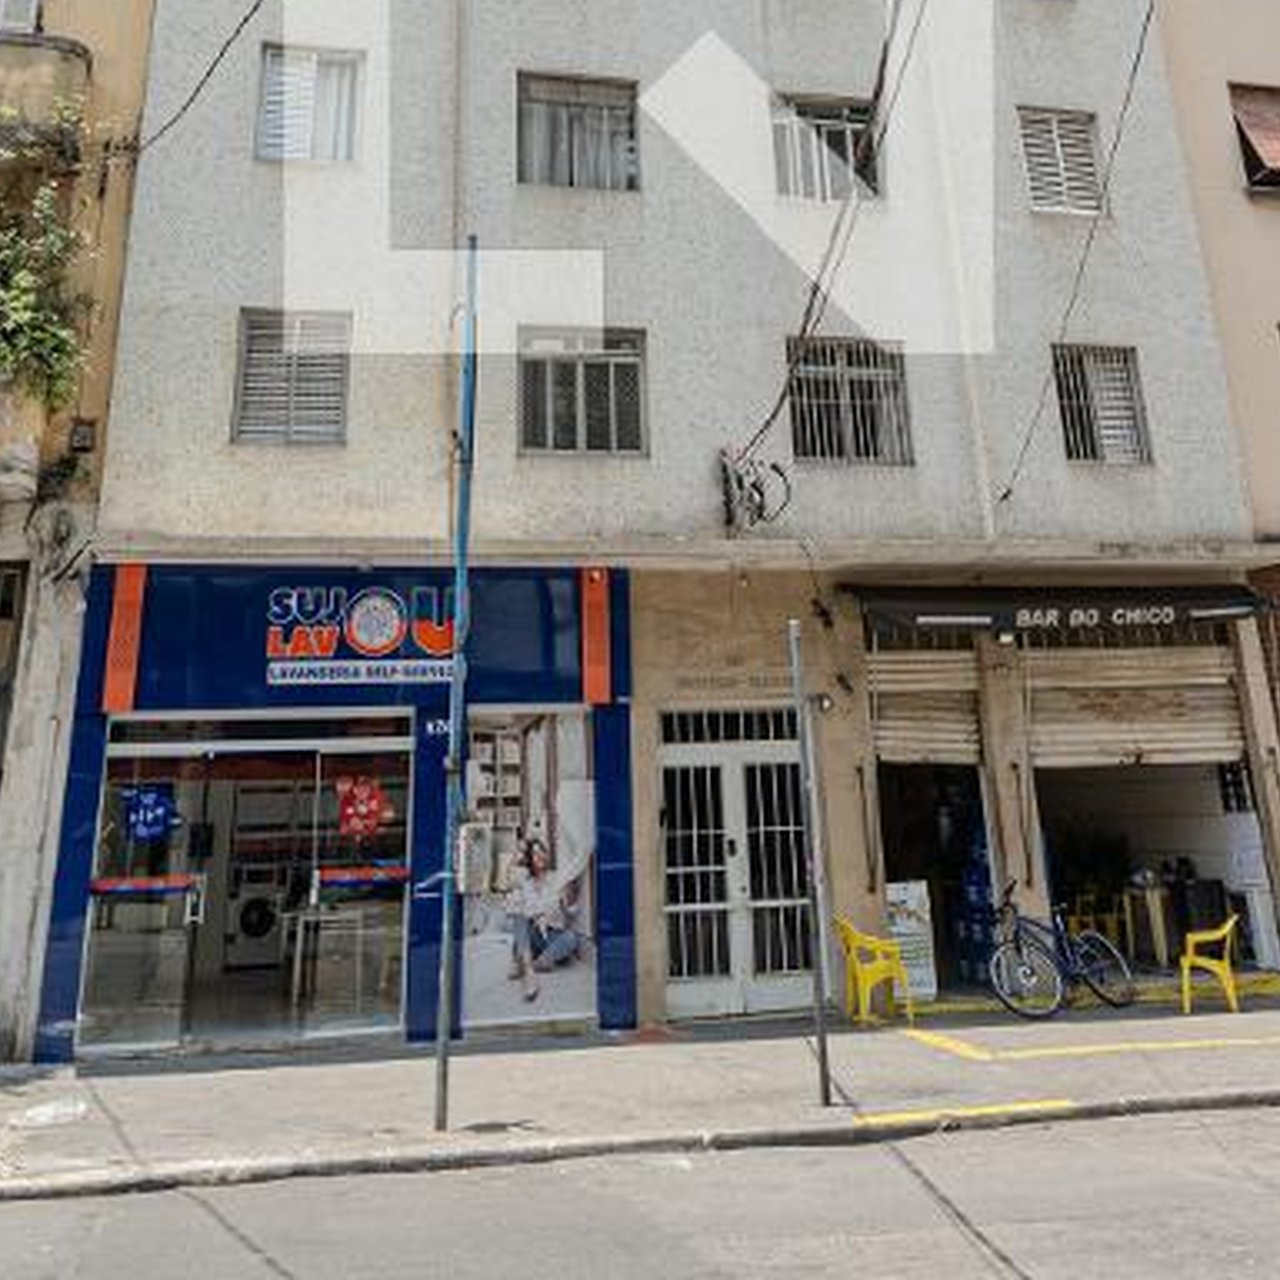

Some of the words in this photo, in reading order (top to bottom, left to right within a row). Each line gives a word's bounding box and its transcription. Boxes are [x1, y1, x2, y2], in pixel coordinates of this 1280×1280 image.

[1016, 608, 1060, 627] BAR
[1070, 608, 1099, 627] DO
[1112, 606, 1175, 625] CHICO
